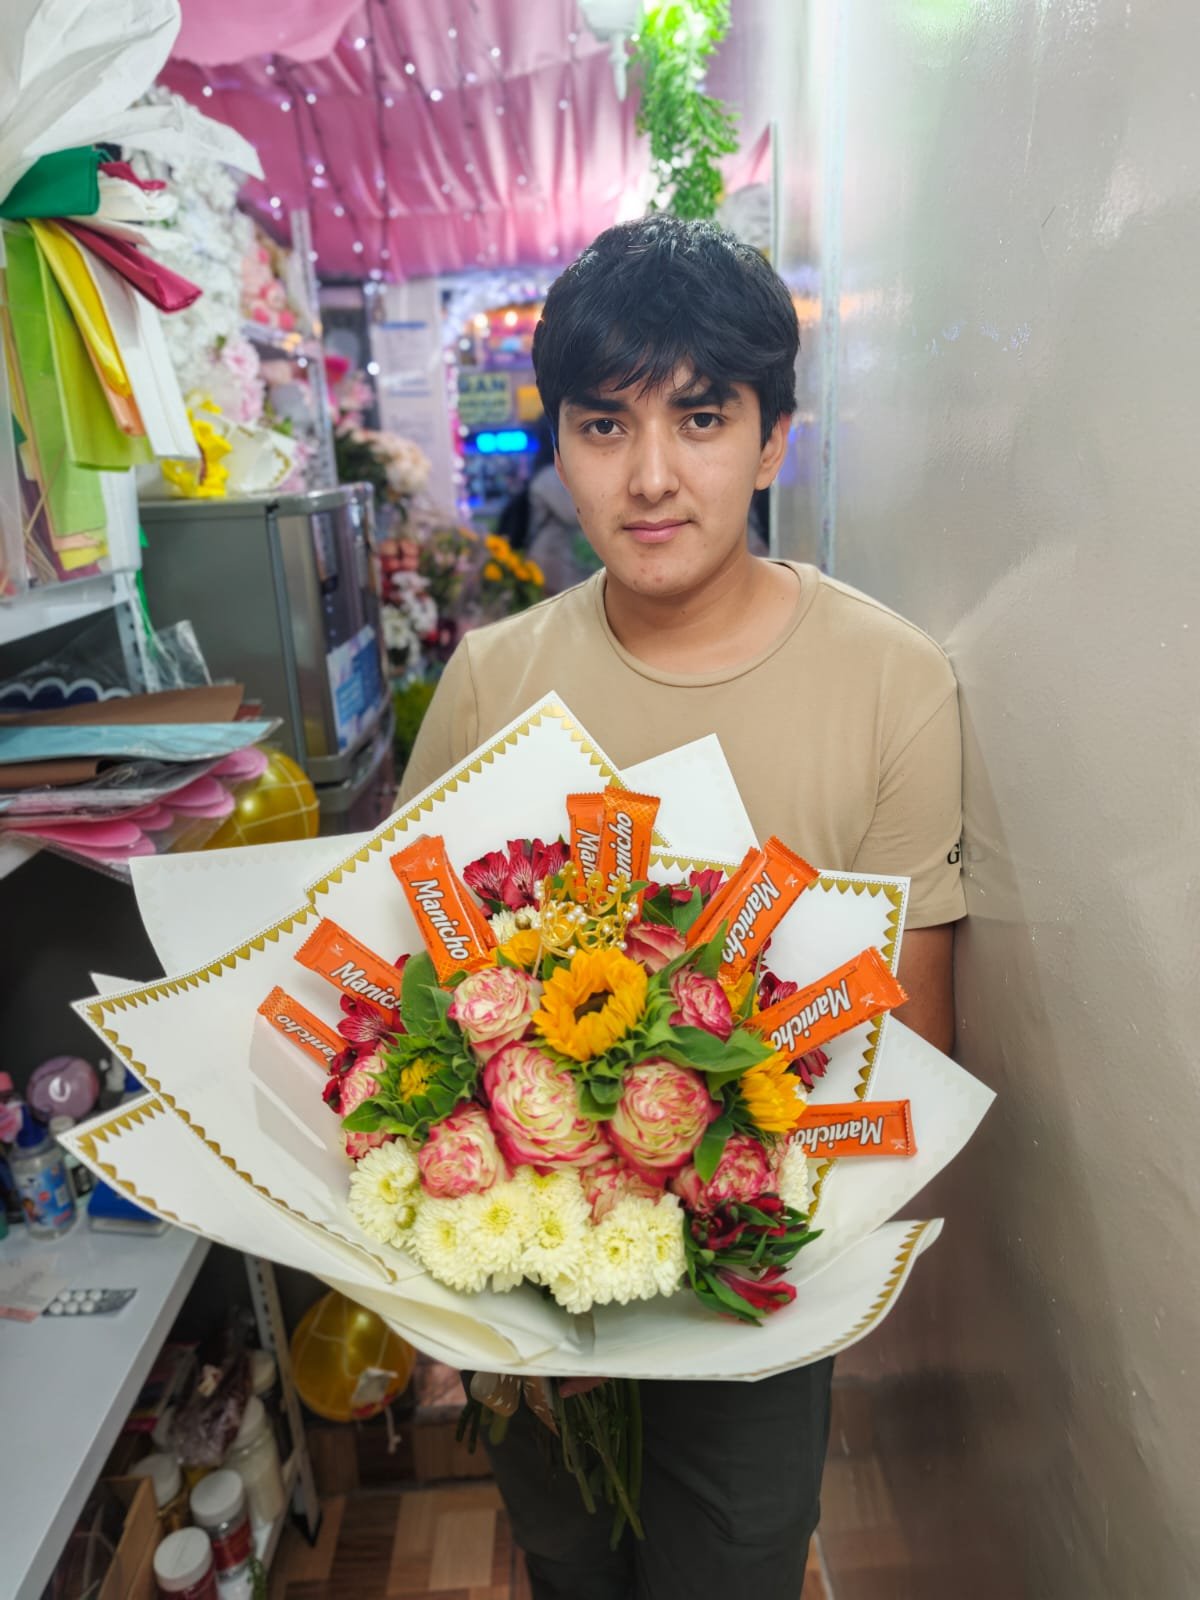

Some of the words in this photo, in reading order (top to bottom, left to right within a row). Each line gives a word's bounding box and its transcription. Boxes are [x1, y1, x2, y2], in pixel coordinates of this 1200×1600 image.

[410, 878, 470, 960] Manicho
[721, 870, 781, 964] Manicho
[275, 1014, 337, 1062] anicho
[769, 978, 852, 1052] Manicho
[793, 1116, 884, 1153] Manicho
